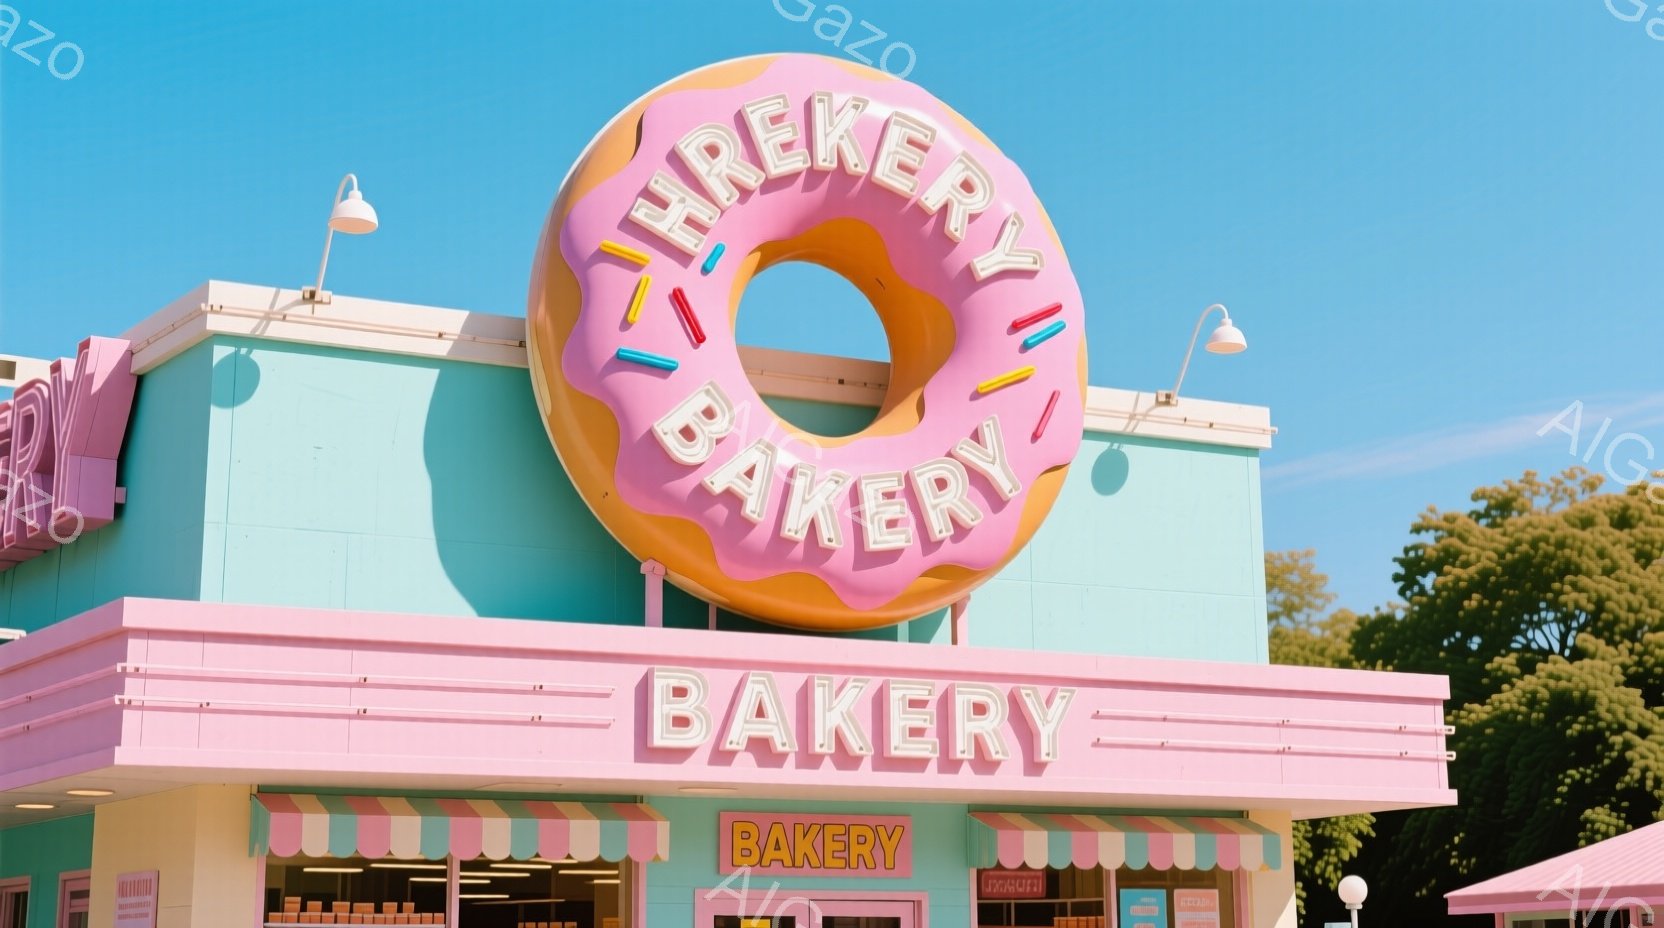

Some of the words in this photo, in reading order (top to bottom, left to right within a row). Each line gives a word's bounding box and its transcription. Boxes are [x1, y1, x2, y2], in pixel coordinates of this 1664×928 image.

[628, 90, 1044, 282] HREKERY
[652, 380, 1022, 552] BAKERY
[646, 666, 1077, 762] BAKERY
[731, 820, 905, 870] BAKERY
